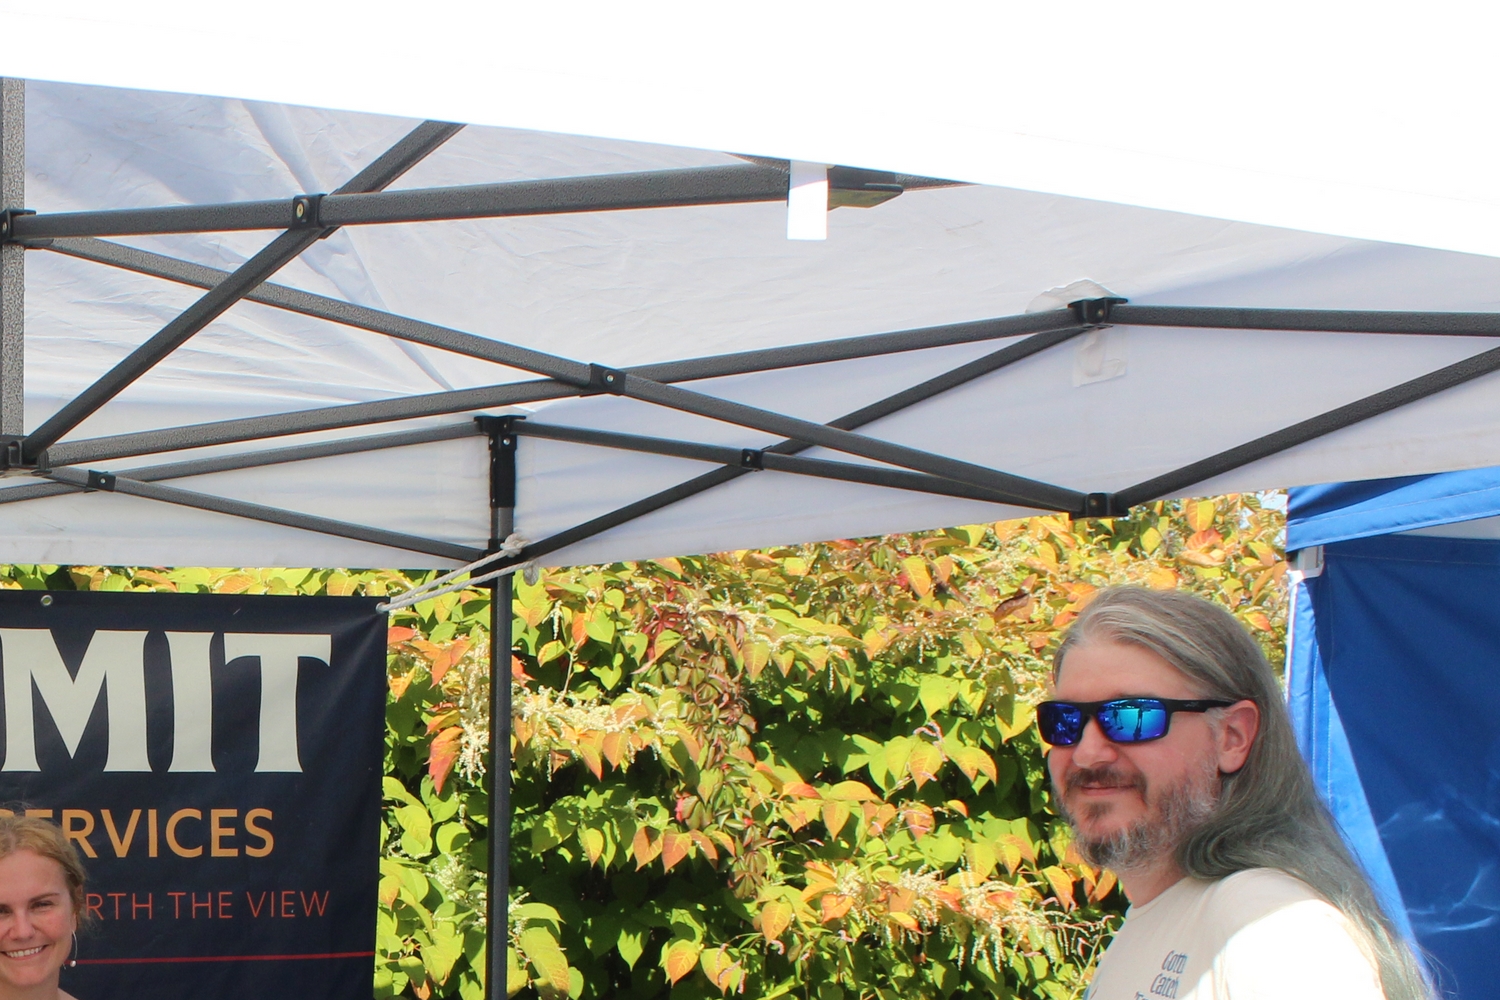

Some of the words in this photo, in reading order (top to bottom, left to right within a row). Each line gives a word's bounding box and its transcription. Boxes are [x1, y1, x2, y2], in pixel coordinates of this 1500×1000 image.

[85, 893, 153, 921] RTH
[168, 892, 233, 919] THE
[245, 890, 330, 918] VIEW
